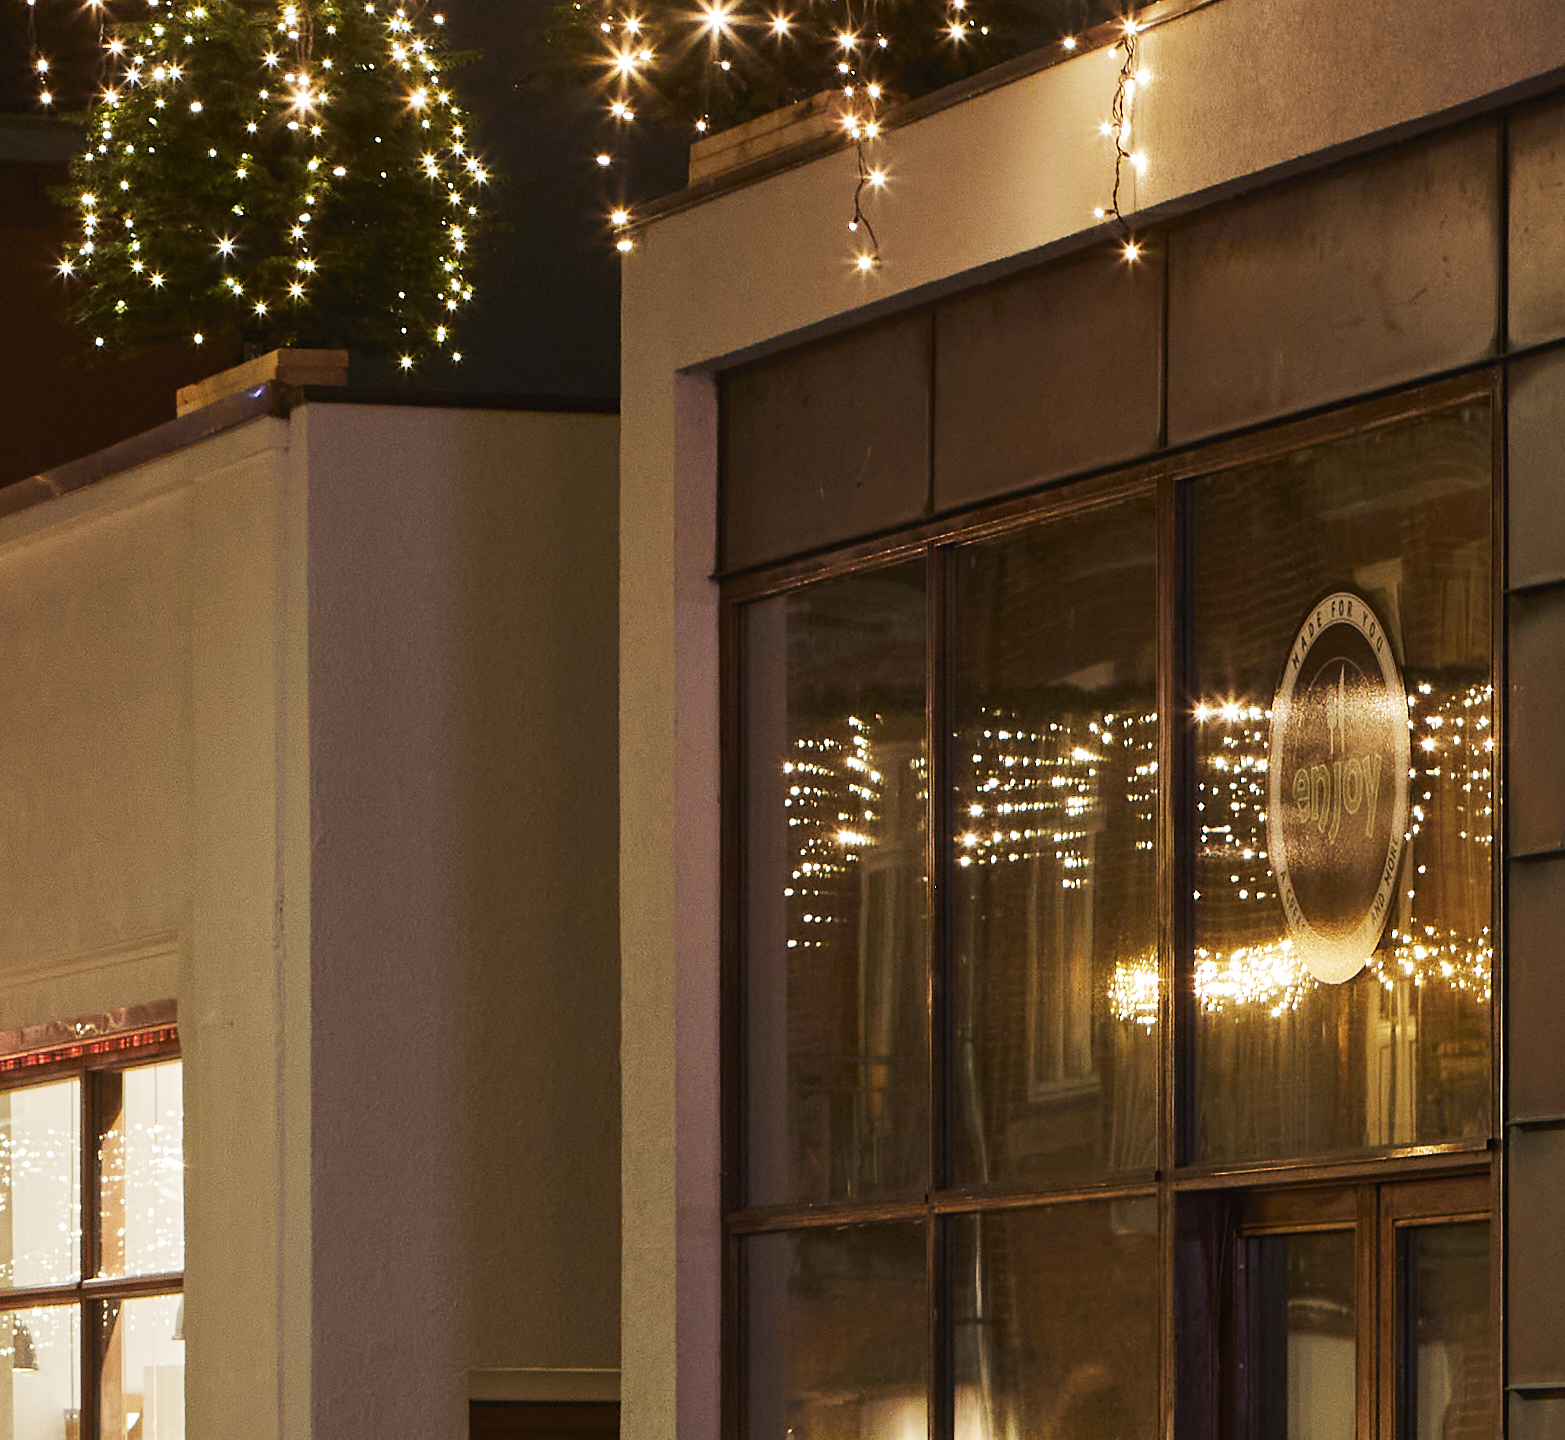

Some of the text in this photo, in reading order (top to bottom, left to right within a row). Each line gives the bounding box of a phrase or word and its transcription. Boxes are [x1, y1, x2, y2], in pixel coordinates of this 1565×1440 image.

[1292, 599, 1384, 670] MADE FOR YOU
[1292, 752, 1383, 845] enjoy
